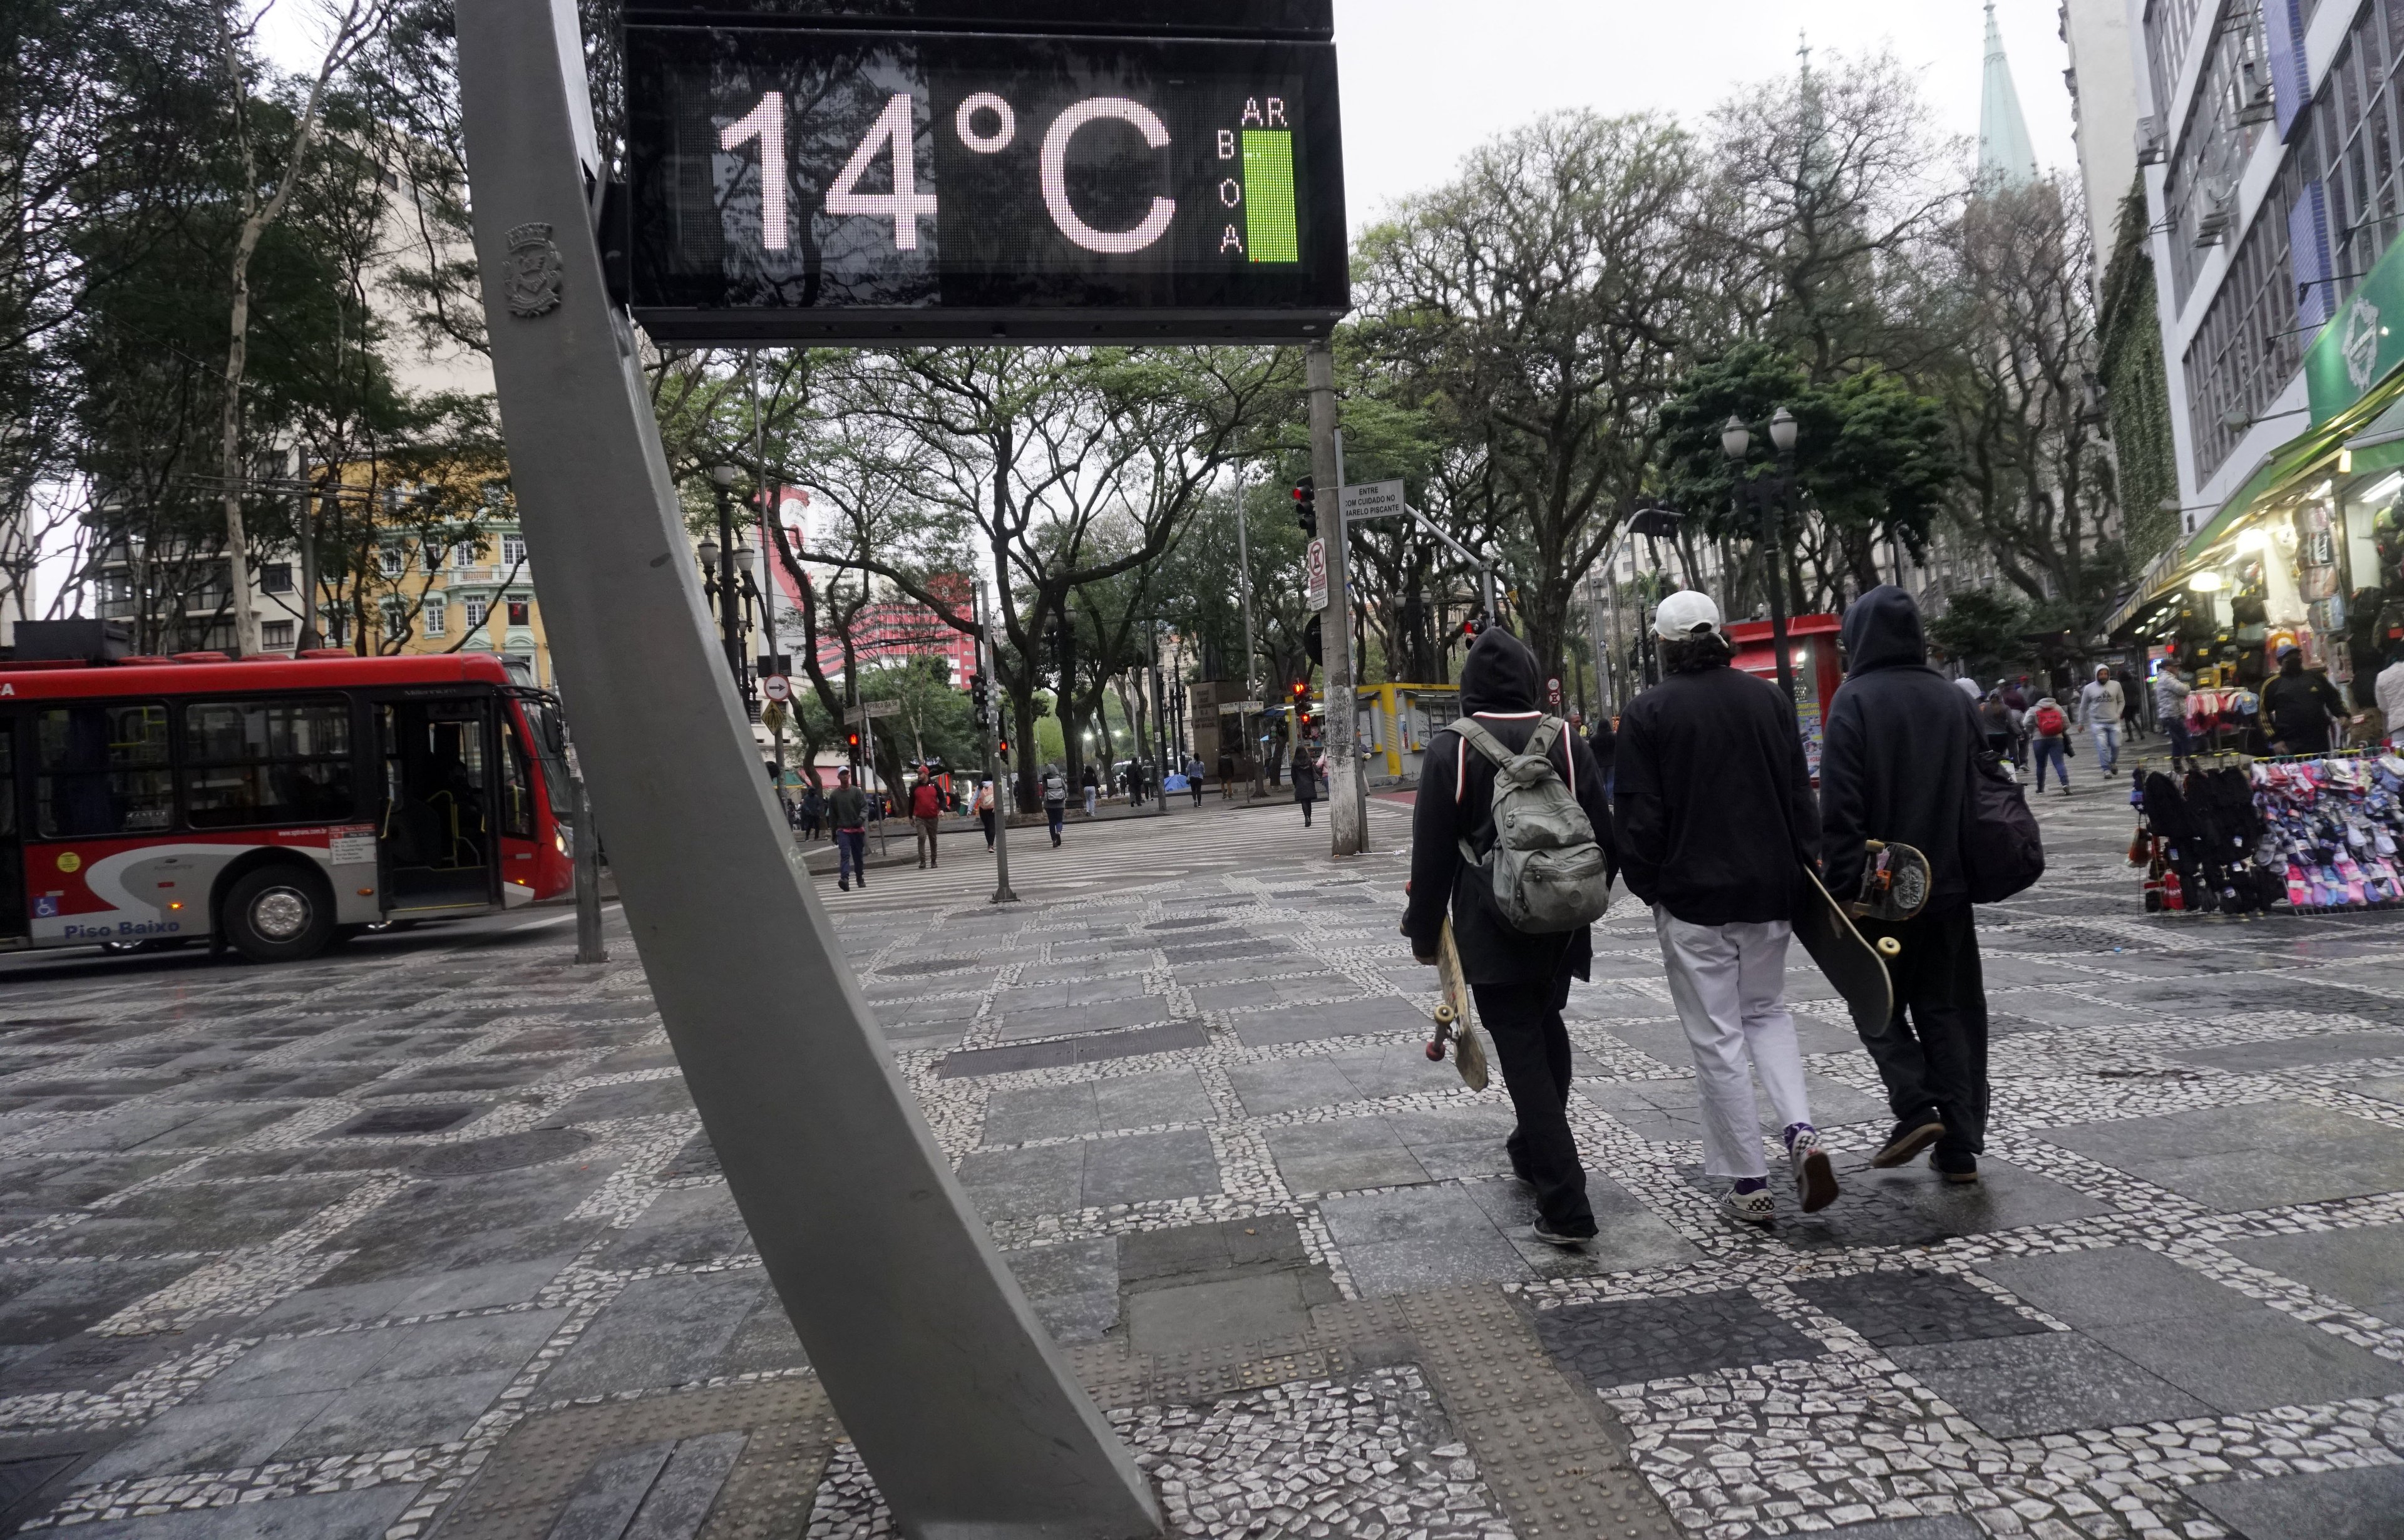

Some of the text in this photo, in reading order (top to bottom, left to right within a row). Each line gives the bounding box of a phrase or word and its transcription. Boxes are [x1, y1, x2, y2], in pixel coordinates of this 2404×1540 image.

[1241, 96, 1288, 126] AR
[720, 91, 1176, 254] 14°C
[1359, 486, 1379, 495] ENTRE
[1358, 495, 1385, 505] CUIDADO
[1346, 504, 1399, 516] MARELO PISCANTE
[870, 702, 883, 710] Praça
[64, 920, 180, 939] Piso Baixo
